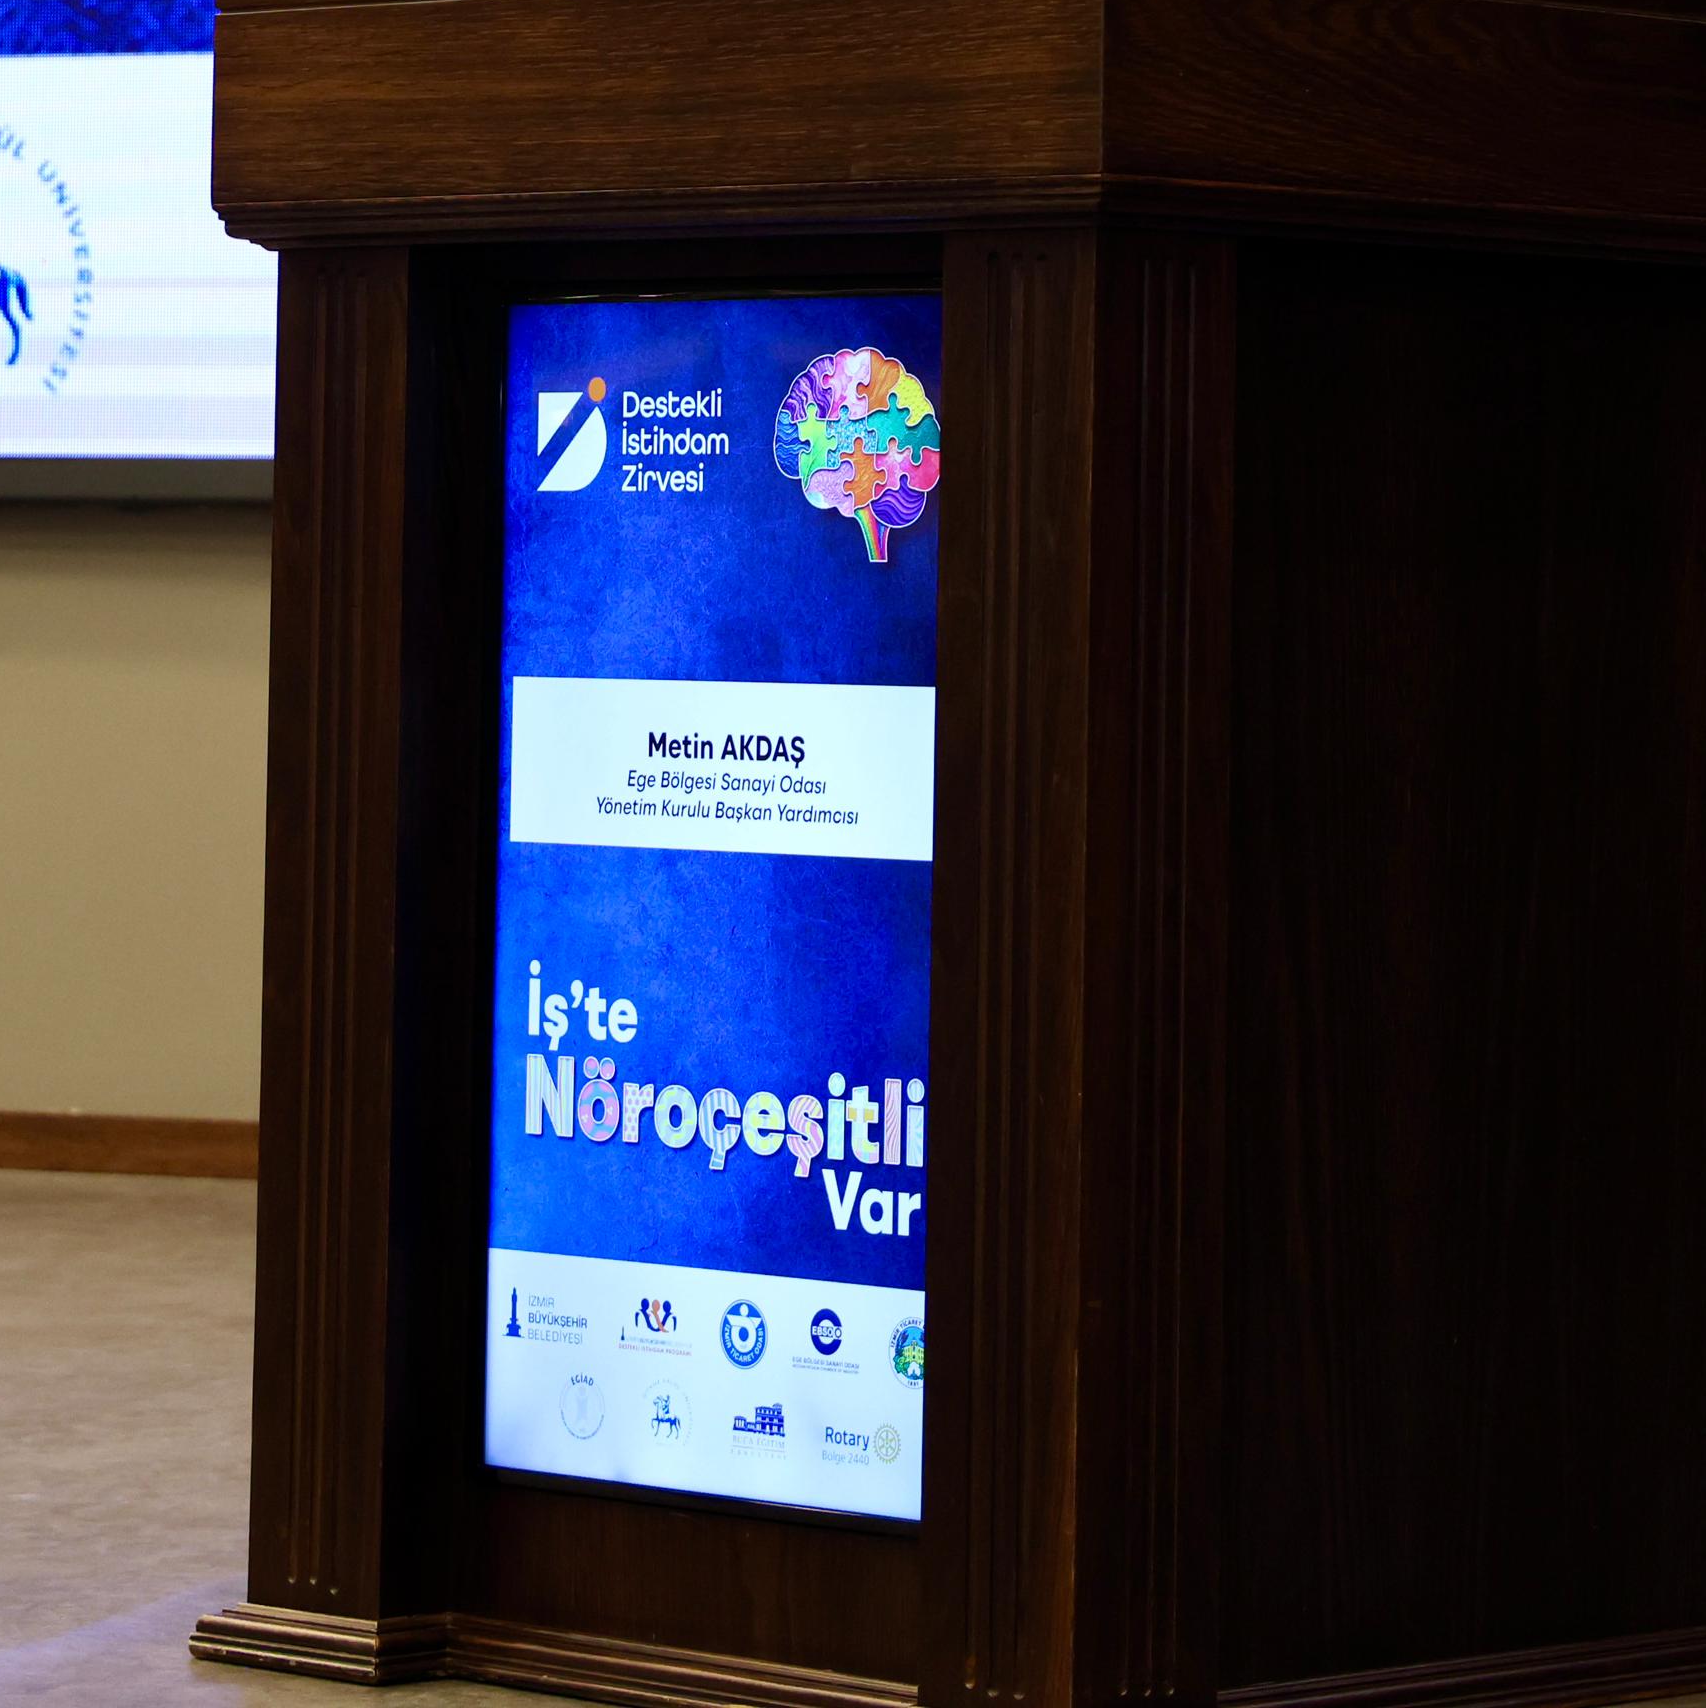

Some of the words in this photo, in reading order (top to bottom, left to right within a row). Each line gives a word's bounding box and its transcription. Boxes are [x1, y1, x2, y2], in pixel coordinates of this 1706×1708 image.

[622, 388, 722, 418] Destekli
[621, 421, 729, 455] İstihdam
[621, 463, 704, 492] Zirvesi
[648, 731, 713, 760] Metin
[721, 735, 805, 768] AKDAŞ
[627, 770, 657, 792] Ege
[661, 771, 717, 793] Bölgesi
[721, 773, 775, 793] Sanayi
[779, 774, 827, 795] Odası
[596, 796, 657, 818] Yönetim
[662, 799, 710, 819] Kurulu
[714, 800, 772, 824] Başkan
[777, 803, 859, 825] Yardımcısı
[524, 1053, 925, 1177] Nöroçeşitli
[821, 1169, 922, 1237] Var
[528, 1310, 587, 1329] BÜYÜKŞEHİR
[825, 1426, 870, 1451] Rotary
